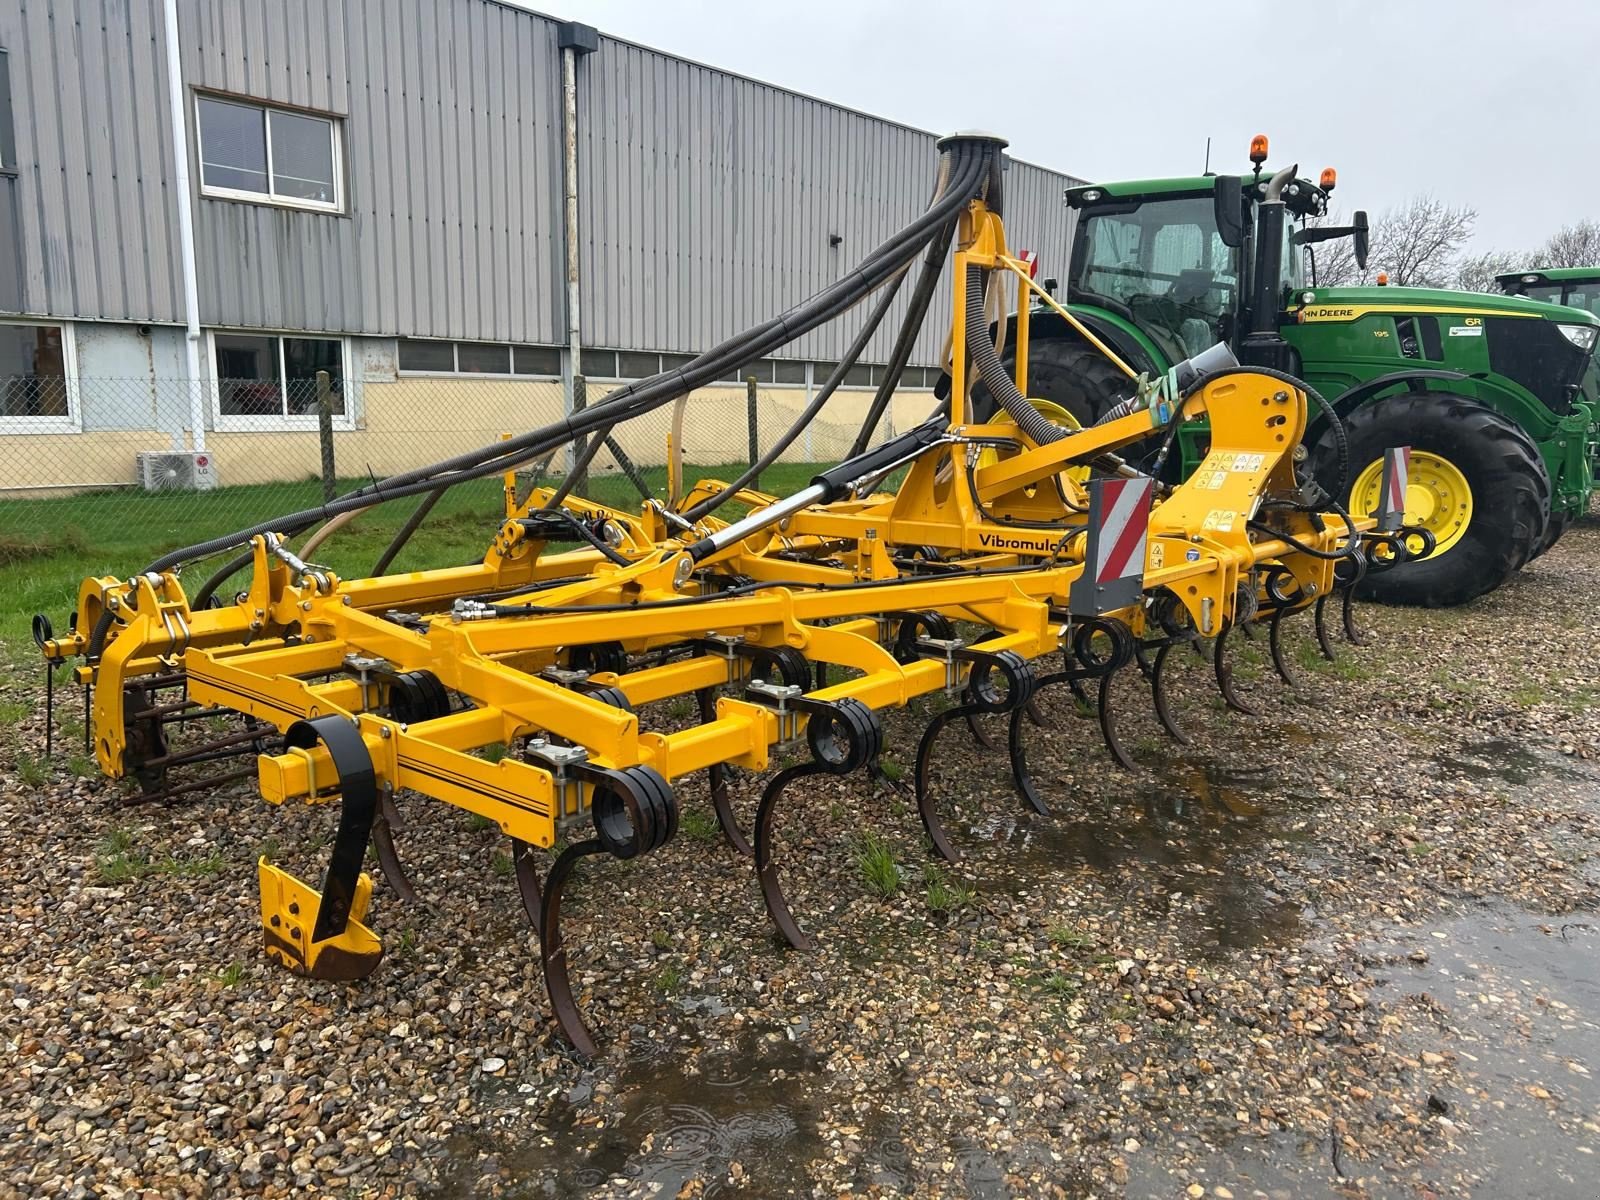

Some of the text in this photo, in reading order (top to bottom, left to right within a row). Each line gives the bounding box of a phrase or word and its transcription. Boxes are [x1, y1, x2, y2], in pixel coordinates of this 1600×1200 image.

[1320, 309, 1353, 317] DEERE
[1465, 317, 1482, 326] 6R
[1373, 330, 1389, 338] 195
[979, 534, 1068, 552] Vibromulch
